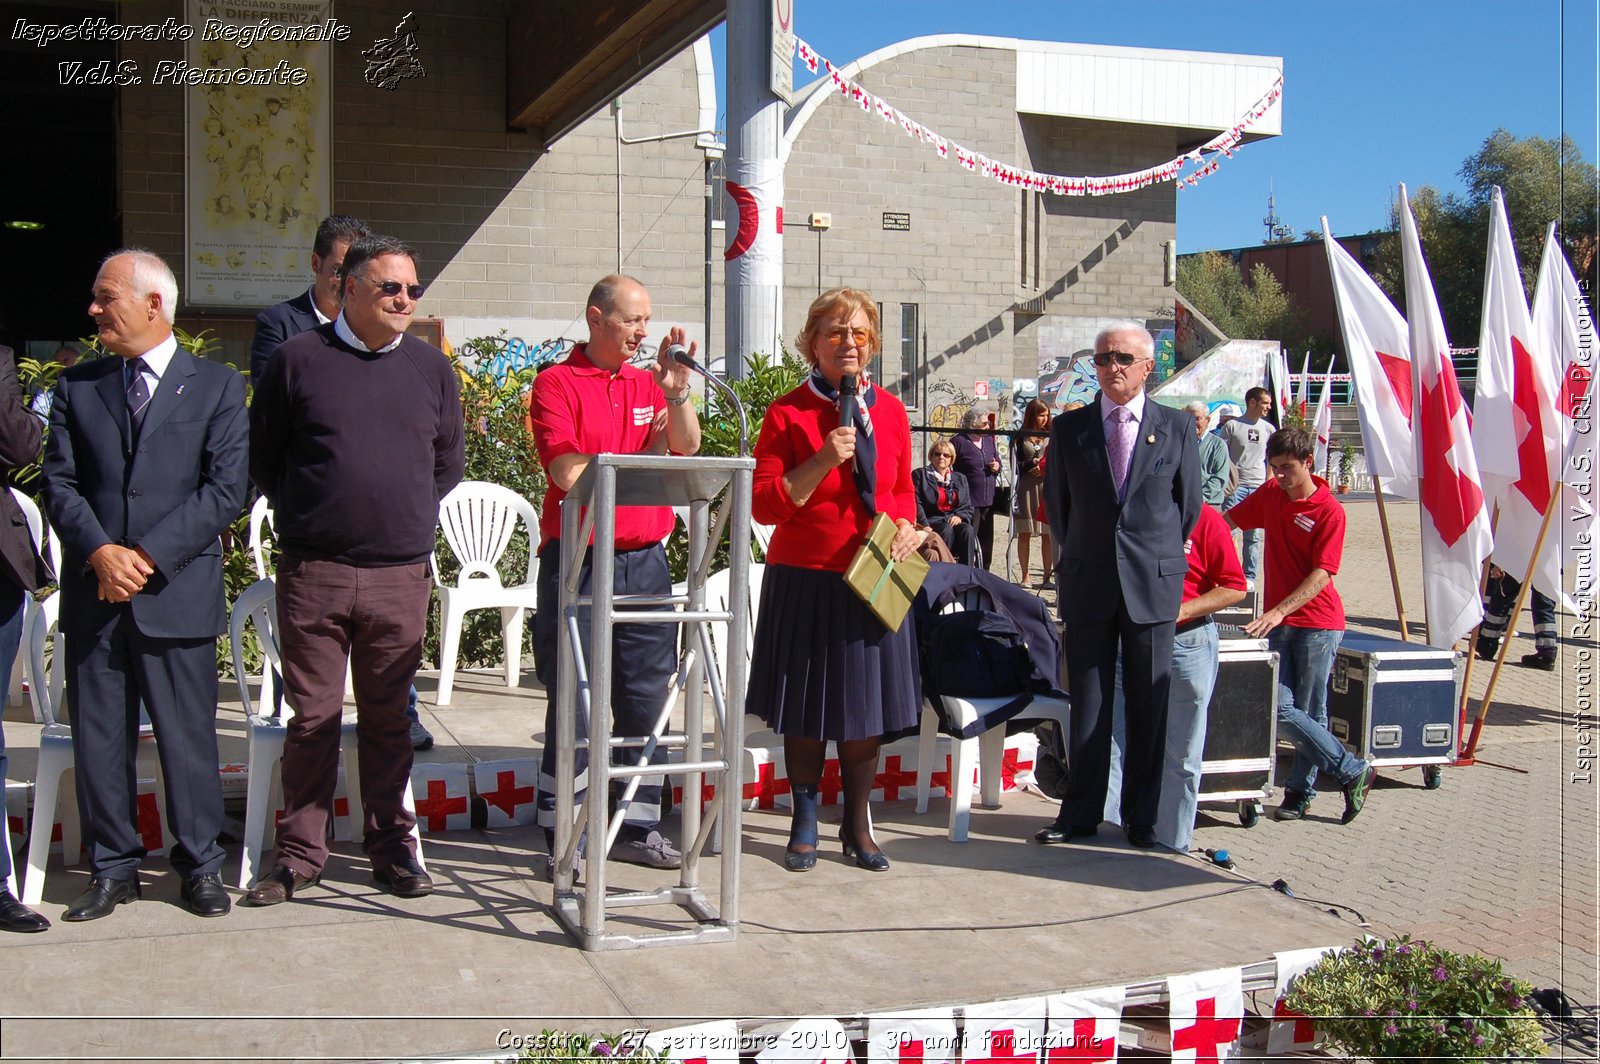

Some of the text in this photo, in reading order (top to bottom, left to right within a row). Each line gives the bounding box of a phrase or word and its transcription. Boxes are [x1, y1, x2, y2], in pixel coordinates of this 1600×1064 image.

[279, 2, 321, 12] SEMPRE
[199, 7, 320, 25] LA DIFFERENZA
